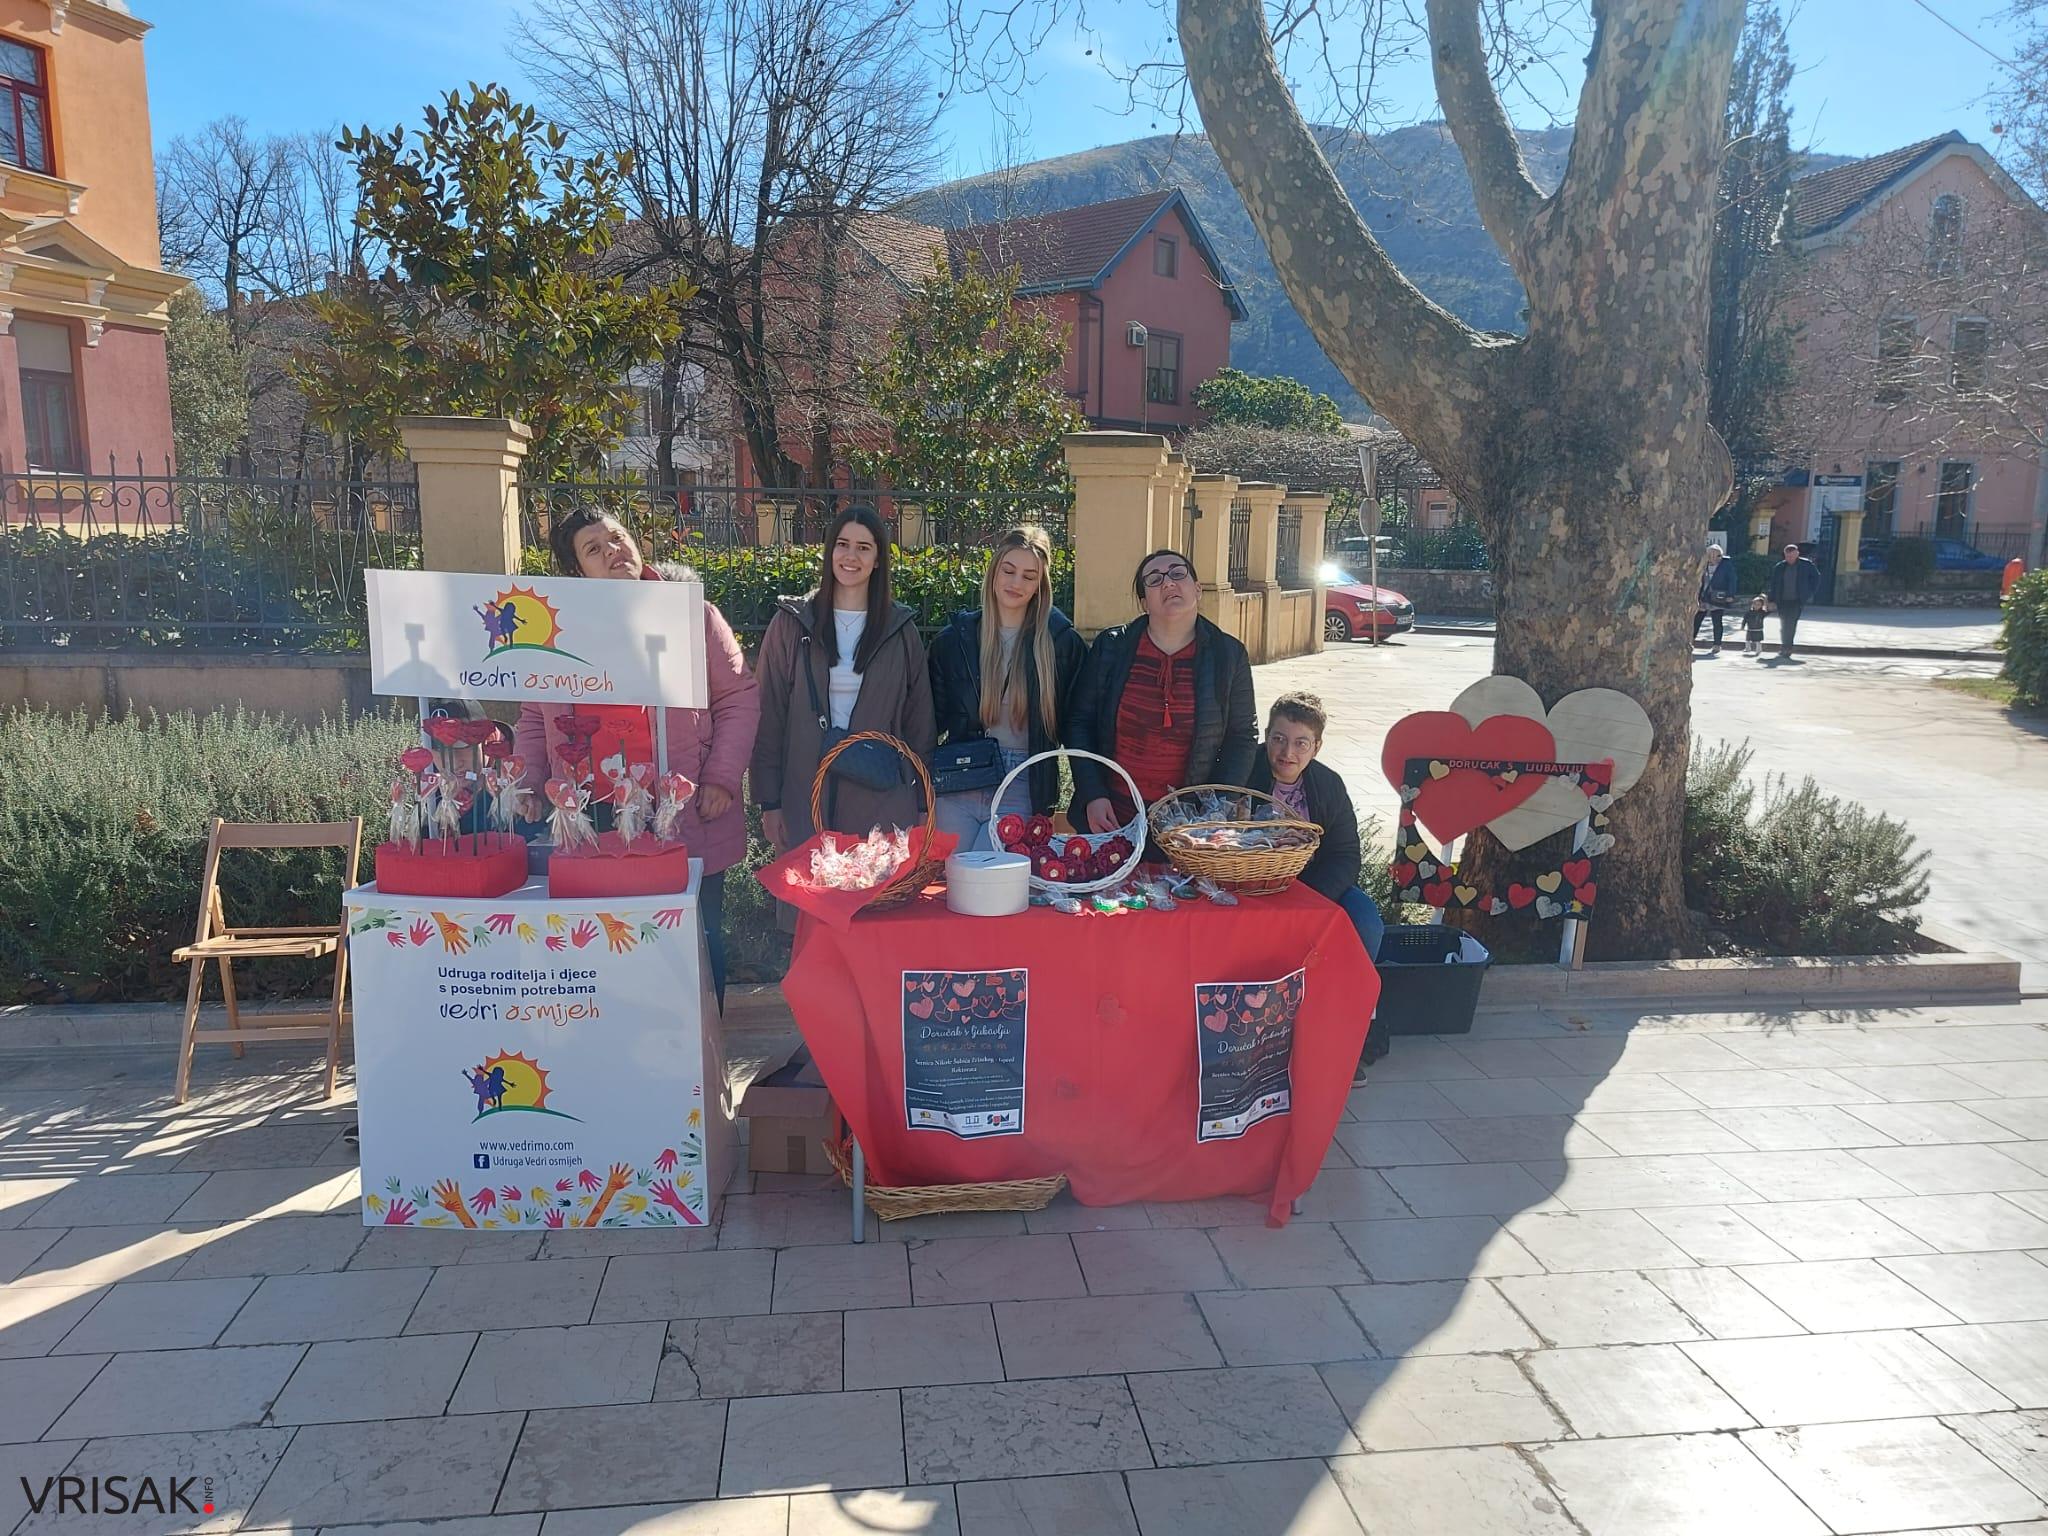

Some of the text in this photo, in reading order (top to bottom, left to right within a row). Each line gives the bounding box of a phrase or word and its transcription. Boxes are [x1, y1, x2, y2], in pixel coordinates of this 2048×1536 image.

[459, 665, 614, 697] vedri osmijeh
[438, 967, 597, 982] Udruga roditelja i djece
[439, 983, 596, 997] s posebnim potrebama
[440, 997, 599, 1026] vedri osmijeh
[480, 1140, 574, 1152] www.vedrimo.com
[493, 1156, 524, 1168] Udruga
[525, 1156, 547, 1166] Vedri
[548, 1155, 583, 1168] osmijeh
